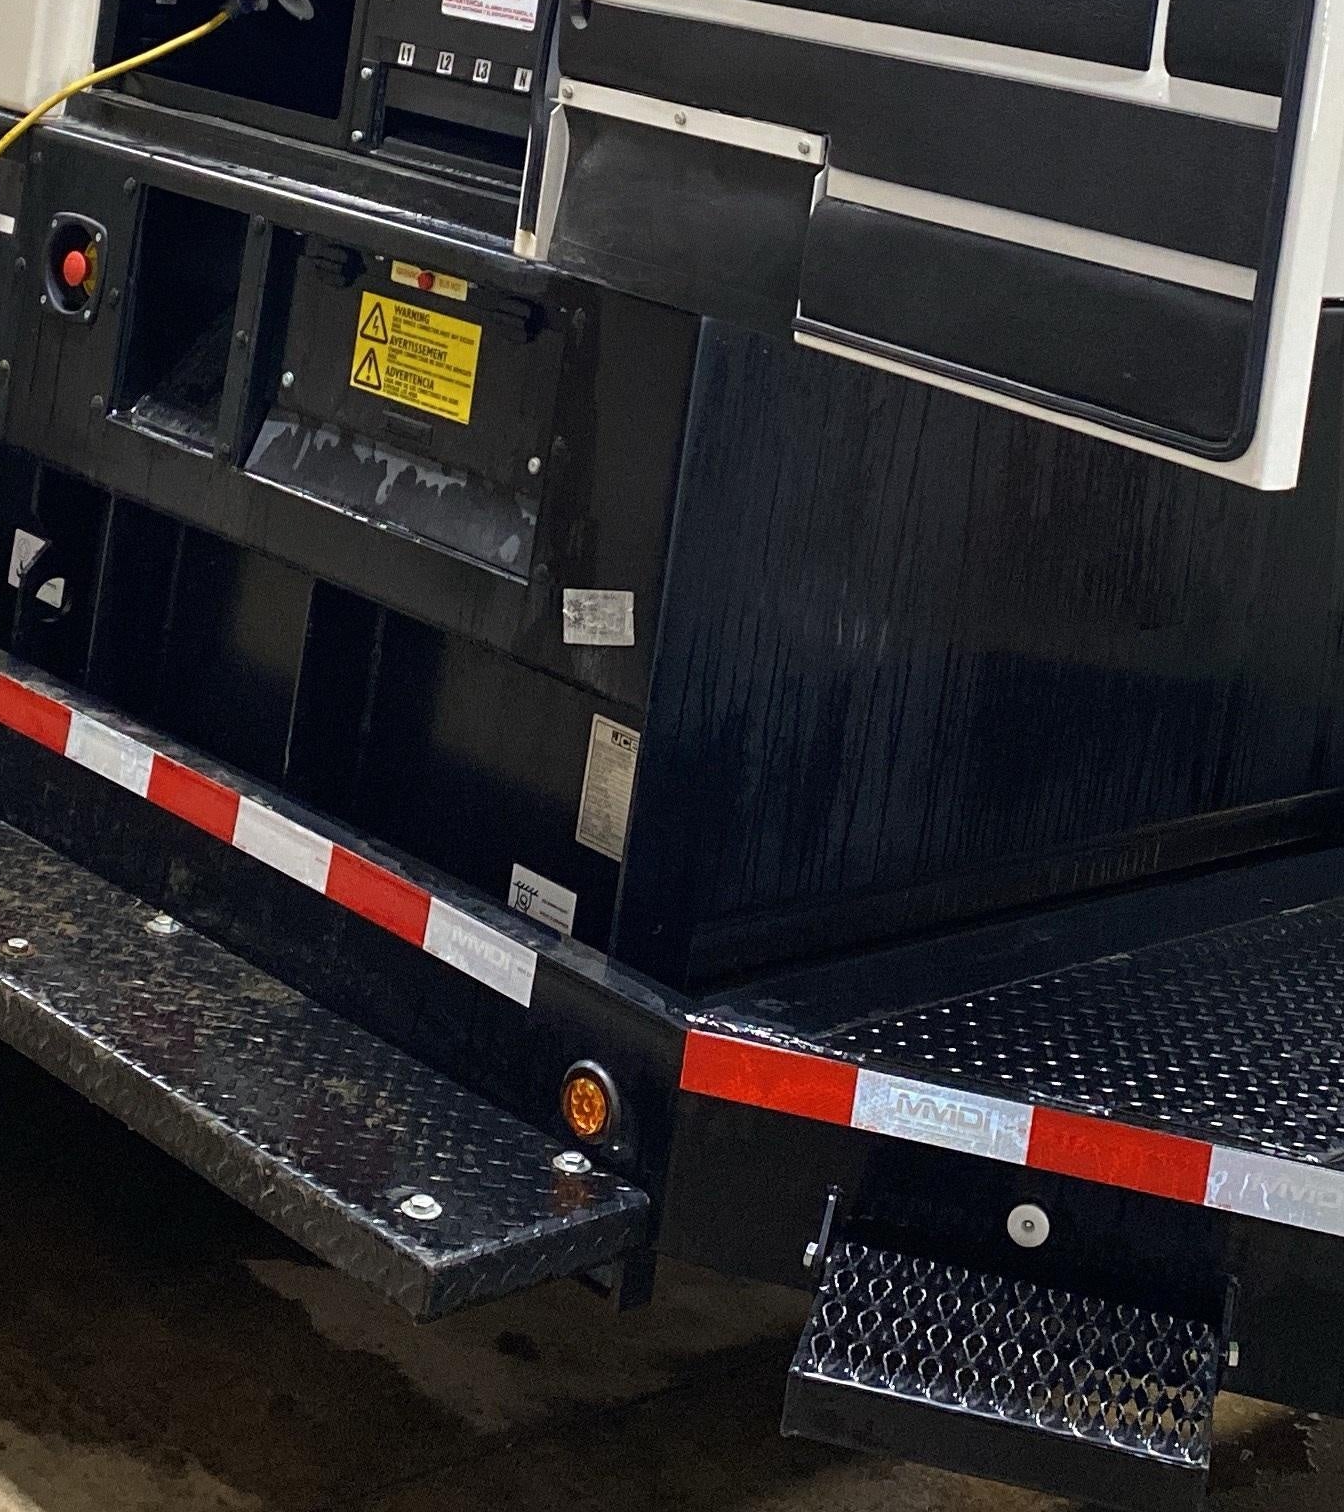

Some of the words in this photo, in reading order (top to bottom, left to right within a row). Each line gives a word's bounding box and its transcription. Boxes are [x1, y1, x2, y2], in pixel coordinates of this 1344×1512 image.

[401, 44, 412, 63] L1
[440, 53, 452, 71] L2
[476, 61, 488, 79] L3
[394, 304, 430, 324] WARNING
[390, 335, 448, 361] AVERTISSEMENT
[385, 365, 435, 391] ADVERTENCIA
